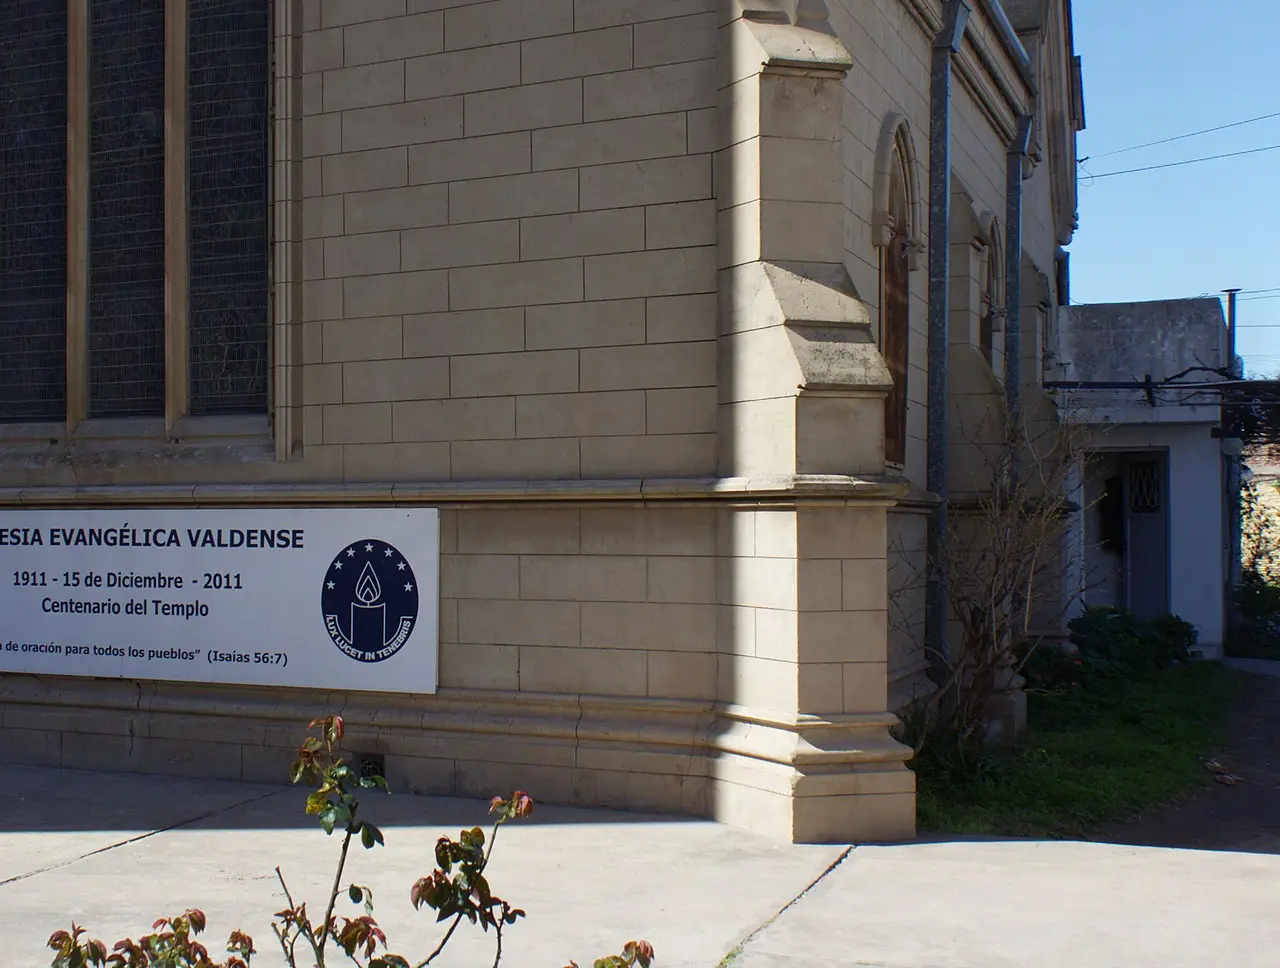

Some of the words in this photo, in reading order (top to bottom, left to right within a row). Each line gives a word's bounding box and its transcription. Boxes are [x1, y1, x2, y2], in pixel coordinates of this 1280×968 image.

[50, 523, 180, 547] EVANGÉLICA
[187, 529, 304, 548] VALDENSE
[13, 571, 47, 586] 1911
[63, 572, 80, 587] 15
[84, 572, 102, 587] de
[107, 572, 183, 588] Diciembre
[203, 573, 242, 589] 2011
[42, 597, 120, 615] Centenario
[125, 599, 147, 615] del
[152, 600, 209, 620] Templo
[326, 616, 339, 637] LUX
[334, 636, 363, 659] LUCET
[365, 652, 375, 660] IN
[376, 620, 411, 658] TENEBRIS
[5, 640, 19, 652] de
[65, 646, 90, 656] para
[93, 645, 125, 657] todos
[128, 646, 145, 658] los
[207, 650, 250, 664] (Isaías
[254, 652, 288, 667] 56:7)
